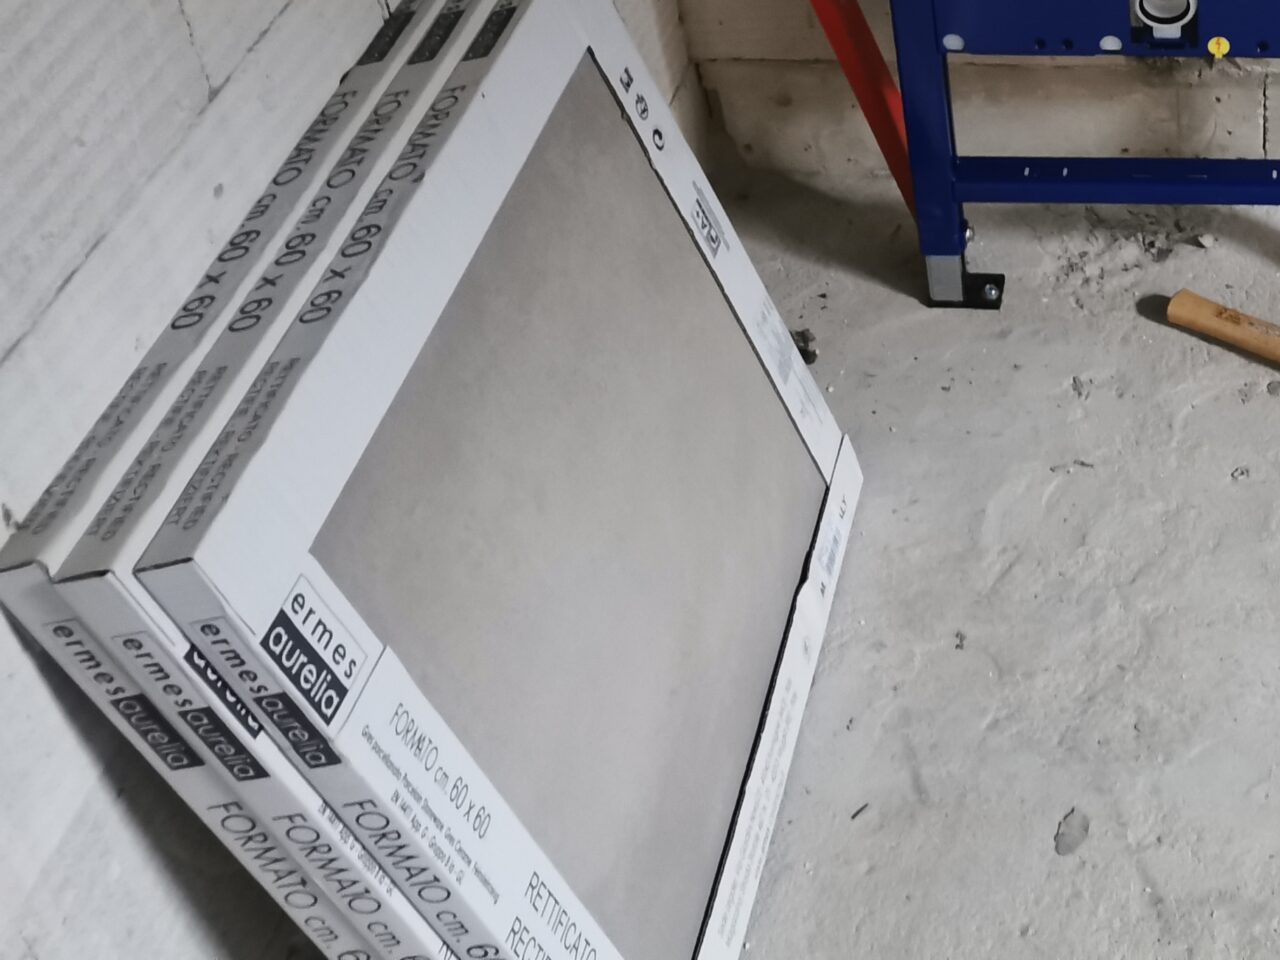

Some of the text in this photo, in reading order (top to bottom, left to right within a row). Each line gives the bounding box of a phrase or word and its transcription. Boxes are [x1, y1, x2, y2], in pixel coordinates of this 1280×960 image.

[272, 90, 358, 187] FORMATO
[326, 90, 410, 189] FORMATO
[389, 84, 466, 181] FORMATO
[197, 271, 227, 289] x
[217, 229, 261, 263] 60
[255, 274, 284, 291] x
[274, 233, 317, 267] 60
[322, 266, 352, 283] x
[341, 224, 382, 258] 60
[170, 295, 216, 330] 60
[228, 297, 273, 332] 60
[299, 289, 343, 324] 60
[268, 626, 341, 718] aurelia
[291, 592, 357, 680] ermes
[52, 624, 188, 768] ermes aurelia
[122, 637, 193, 708] ermes
[186, 709, 255, 779] aurelia
[199, 623, 269, 695] ermes
[261, 695, 328, 767] aurelia
[389, 702, 439, 772] FORMATO
[449, 775, 469, 810] 60
[463, 799, 476, 822] x
[473, 806, 491, 839] 60
[206, 800, 318, 910] FORMATO
[304, 915, 339, 949] cm.
[271, 812, 382, 916] FORMATO
[367, 921, 401, 955] cm.
[342, 798, 452, 905] FORMATO
[435, 910, 470, 943] cm.
